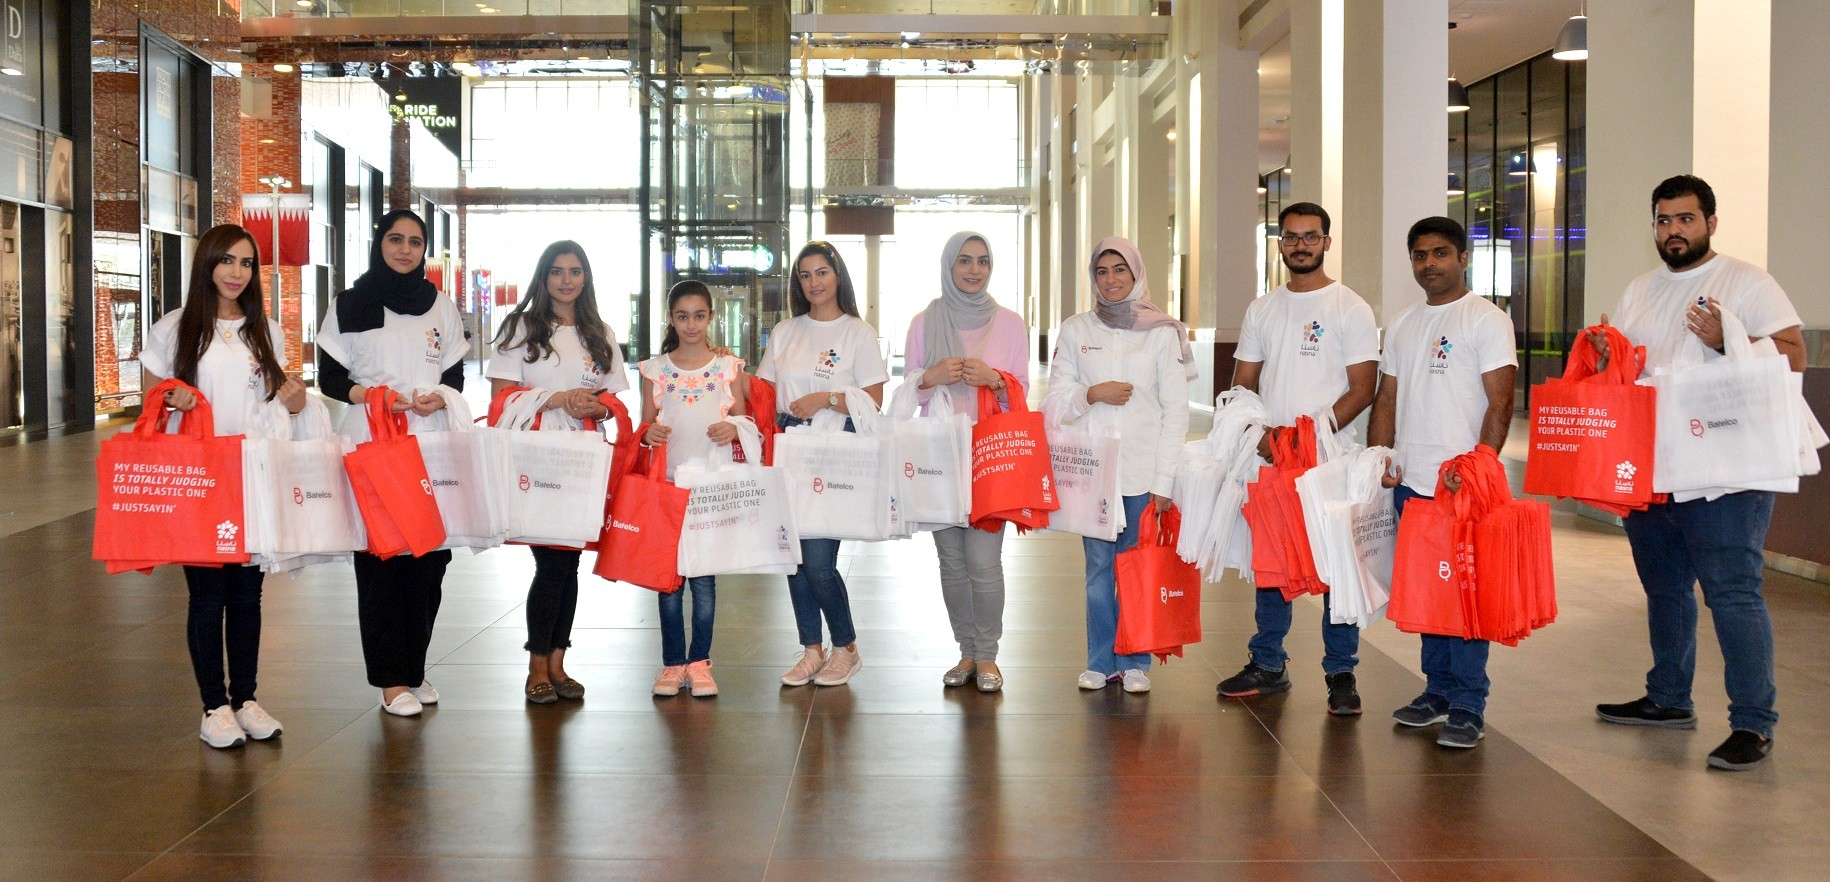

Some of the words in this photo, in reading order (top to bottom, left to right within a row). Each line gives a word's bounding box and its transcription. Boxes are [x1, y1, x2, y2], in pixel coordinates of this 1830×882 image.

[404, 104, 437, 116] RIDE
[404, 116, 456, 127] TION
[1539, 406, 1550, 415] MY
[1550, 407, 1586, 416] REUSABLE
[1588, 408, 1608, 417] BAG
[1538, 416, 1547, 424] IS
[1547, 417, 1576, 426] TOTALLY
[1576, 417, 1617, 429] JUDGING
[1707, 418, 1738, 429] Batelco
[1537, 426, 1555, 435] YOUR
[1556, 427, 1586, 437] PLASTIC
[1588, 428, 1608, 438] ONE
[975, 431, 1013, 448] REUSABLE
[1014, 430, 1029, 438] BAG
[975, 441, 1004, 457] TOTALLY
[1006, 439, 1036, 448] JUDGING
[1078, 448, 1093, 457] BAG
[986, 448, 1018, 461] PLASTIC
[1019, 448, 1033, 456] ONE
[1050, 454, 1070, 464] TALLY
[1070, 457, 1100, 467] JUDGING
[114, 462, 131, 472] MY
[132, 463, 184, 475] REUSABLE
[186, 466, 206, 476] BAG
[917, 467, 943, 476] Batelco
[1053, 464, 1079, 475] PLASTIC
[1080, 467, 1094, 476] ONE
[113, 473, 125, 483] IS
[128, 474, 169, 485] TOTALLY
[170, 476, 216, 487] JUDGING
[432, 479, 459, 487] Batelco
[534, 480, 561, 490] Batelco
[113, 485, 140, 495] YOUR
[142, 486, 184, 497] PLASTIC
[186, 488, 207, 498] ONE
[699, 482, 738, 494] REUSABLE
[740, 479, 757, 488] BAG
[827, 482, 854, 491] Batelco
[306, 491, 332, 499] Batelco
[697, 493, 729, 505] TOTALLY
[730, 488, 766, 500] JUDGING
[687, 507, 709, 516] YOUR
[711, 501, 741, 513] PLASTIC
[743, 498, 761, 508] ONE
[613, 520, 640, 533] Batelco
